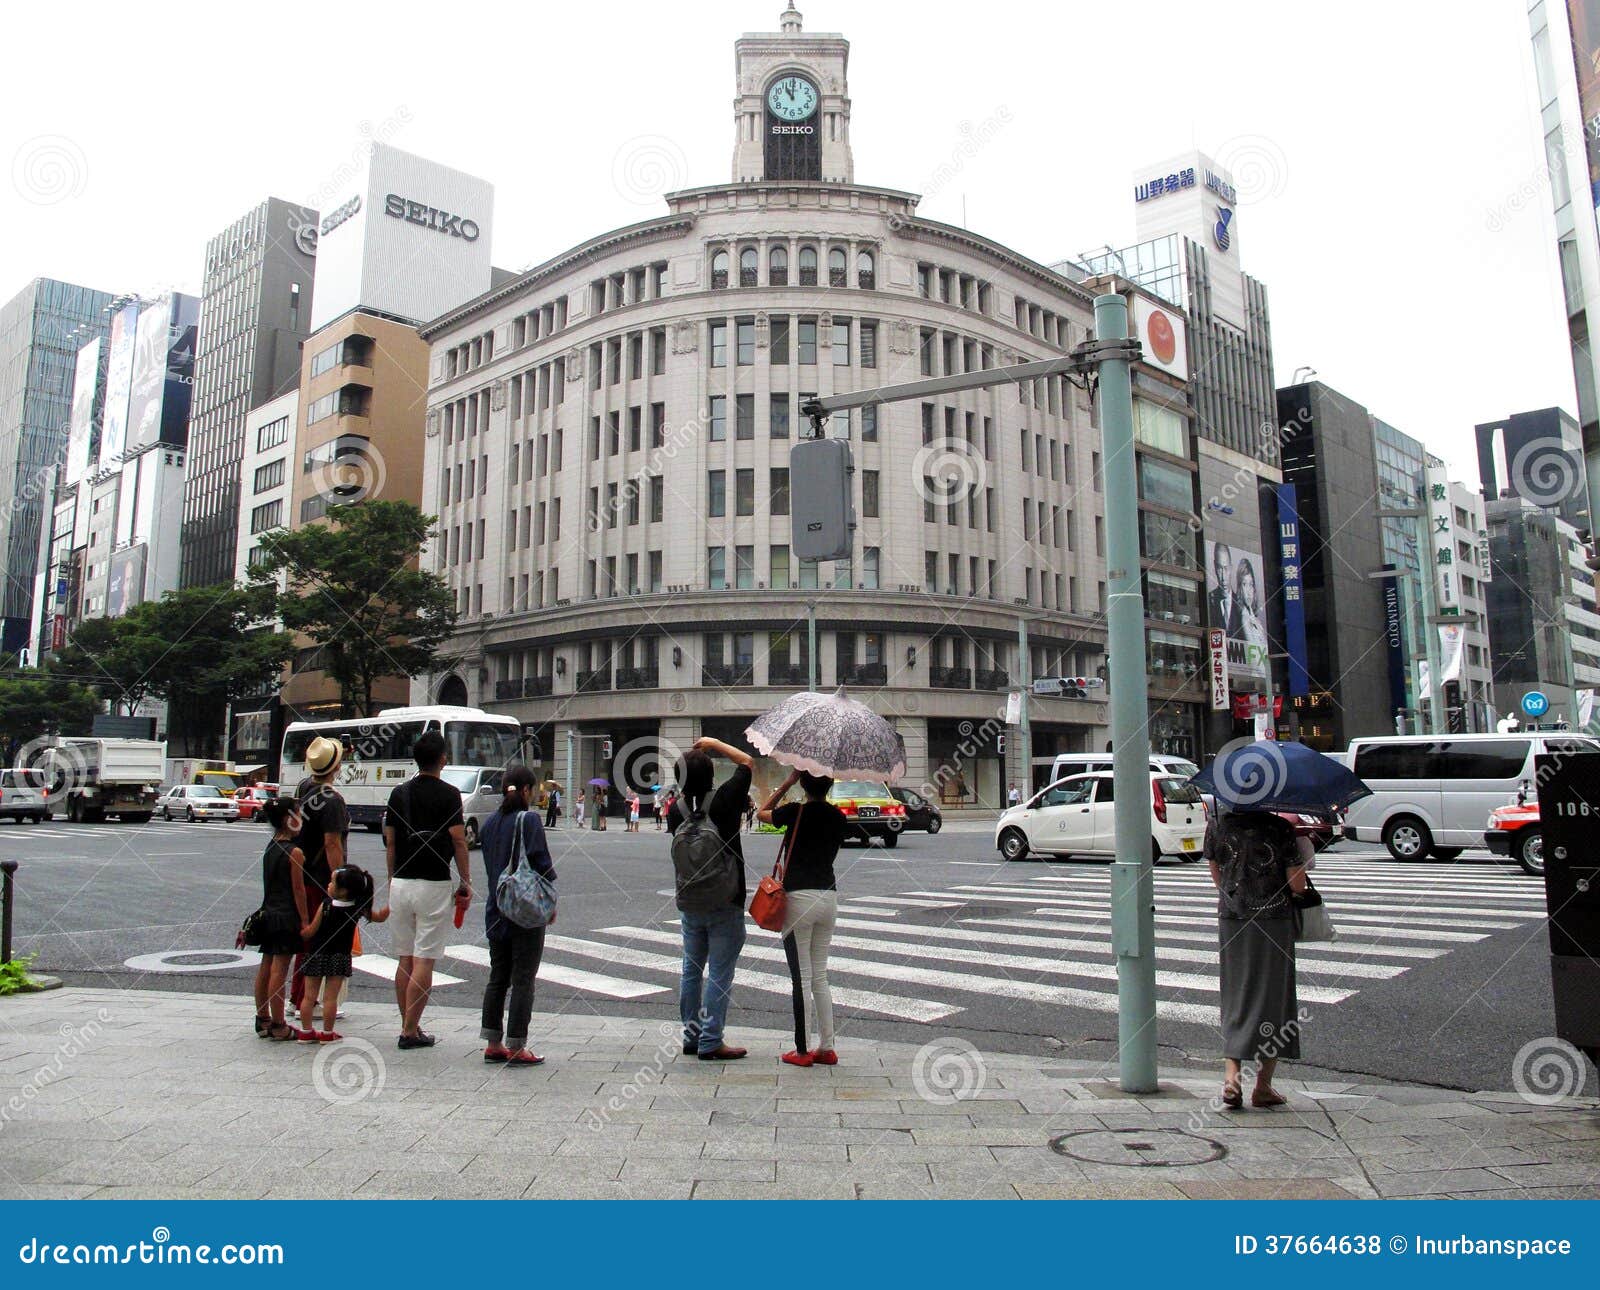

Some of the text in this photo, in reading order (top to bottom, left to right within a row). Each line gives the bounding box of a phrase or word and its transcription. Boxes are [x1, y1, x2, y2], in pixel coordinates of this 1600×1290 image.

[772, 126, 814, 135] SEIKO
[1135, 168, 1196, 203] 山野楽器
[384, 193, 480, 242] SEIKO
[1431, 482, 1452, 566] 教文館
[1281, 522, 1301, 601] 山野楽器
[1386, 587, 1400, 647] MIKIMOTO
